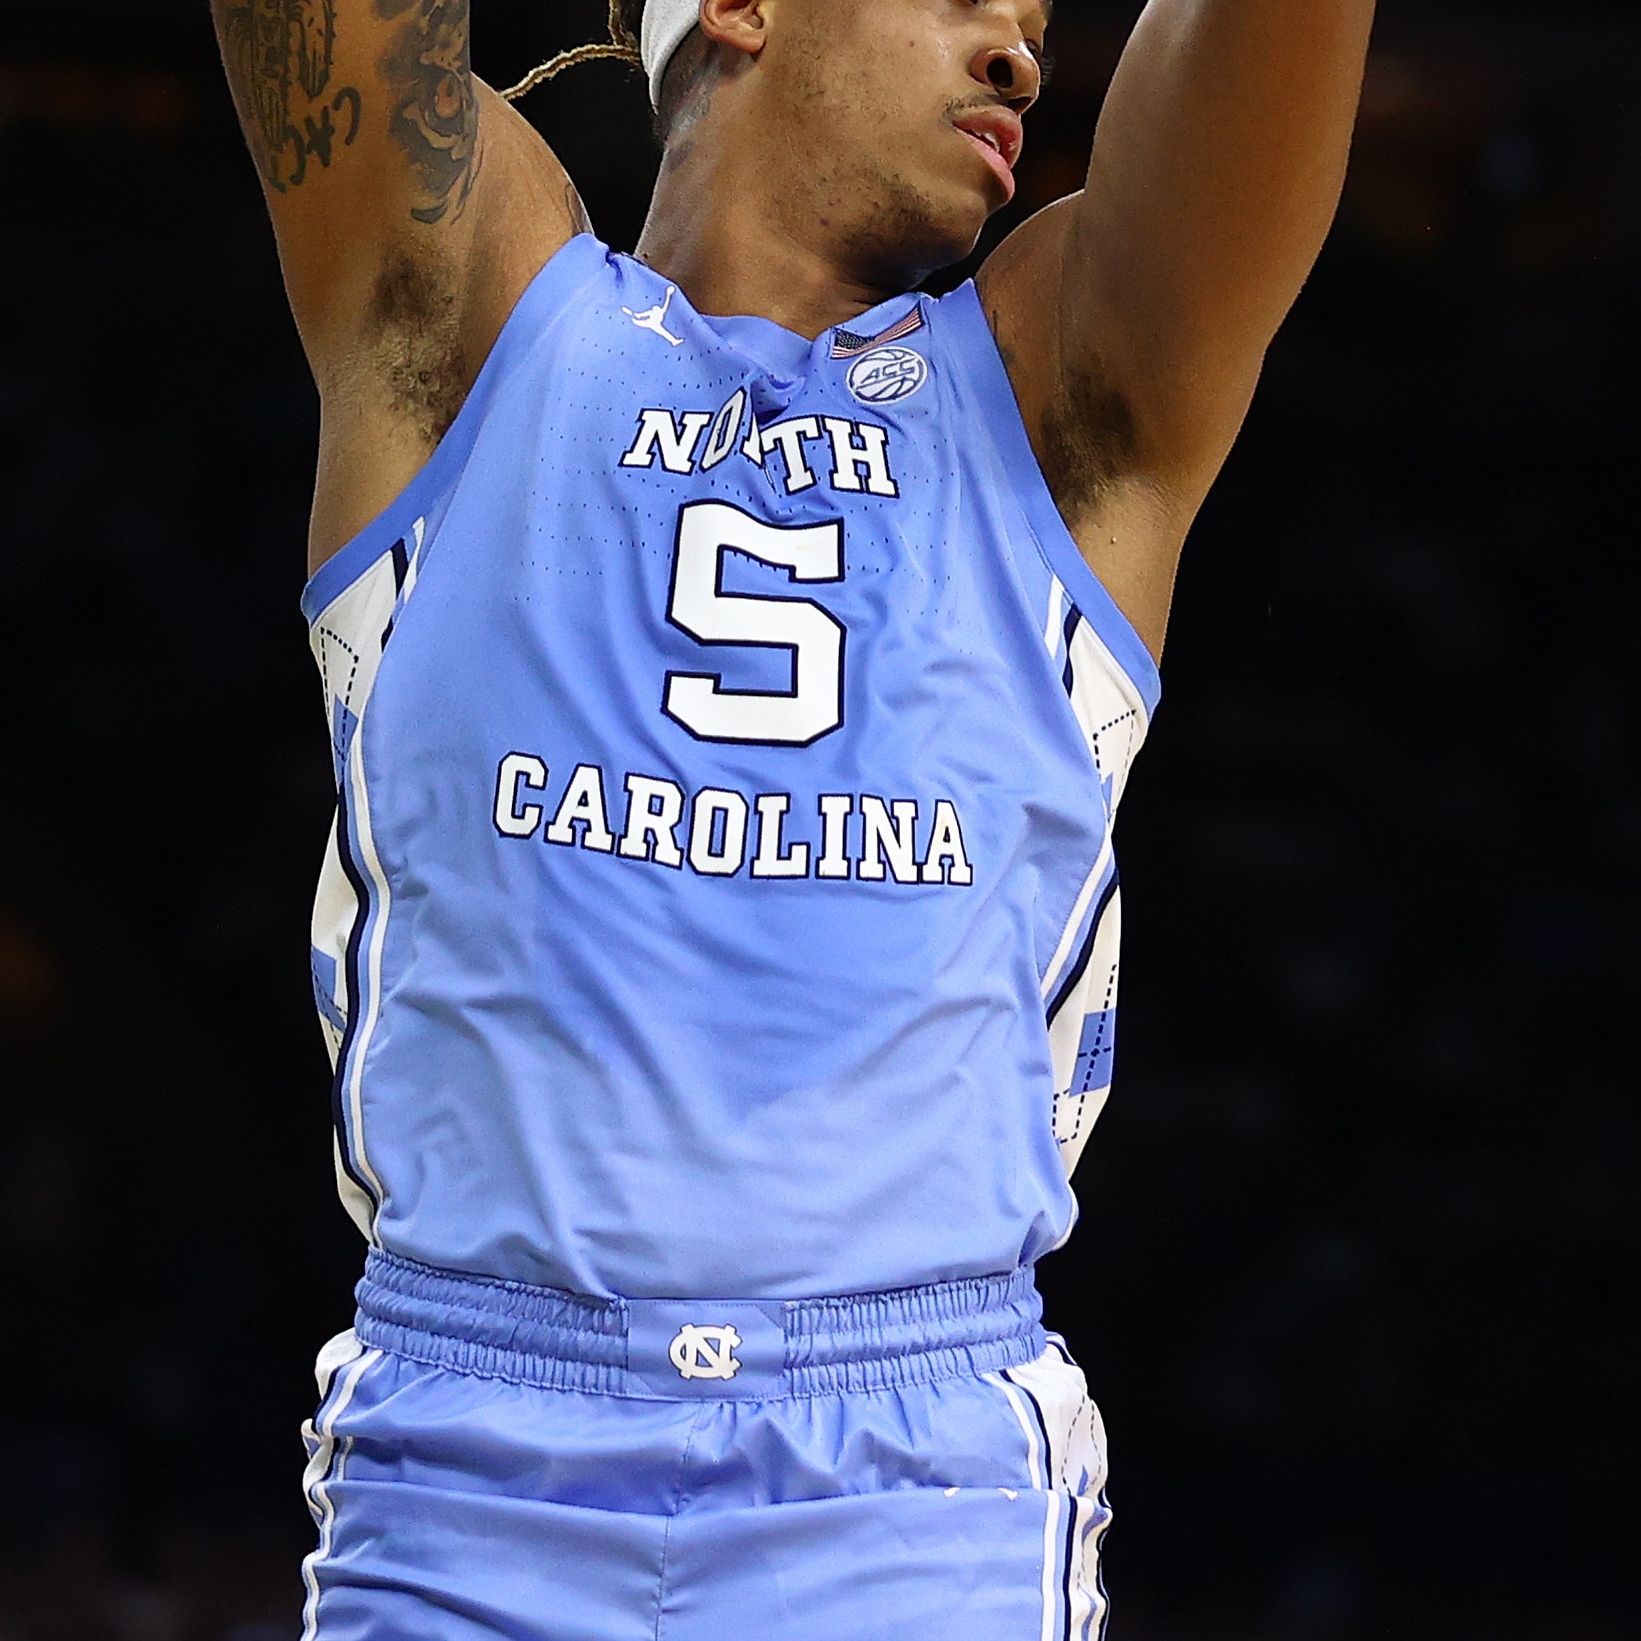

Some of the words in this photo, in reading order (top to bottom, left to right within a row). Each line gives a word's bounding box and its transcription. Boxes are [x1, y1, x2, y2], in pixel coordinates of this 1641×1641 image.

[618, 386, 900, 499] NOTH
[662, 500, 846, 749] 5
[494, 752, 974, 887] CAROLINA
